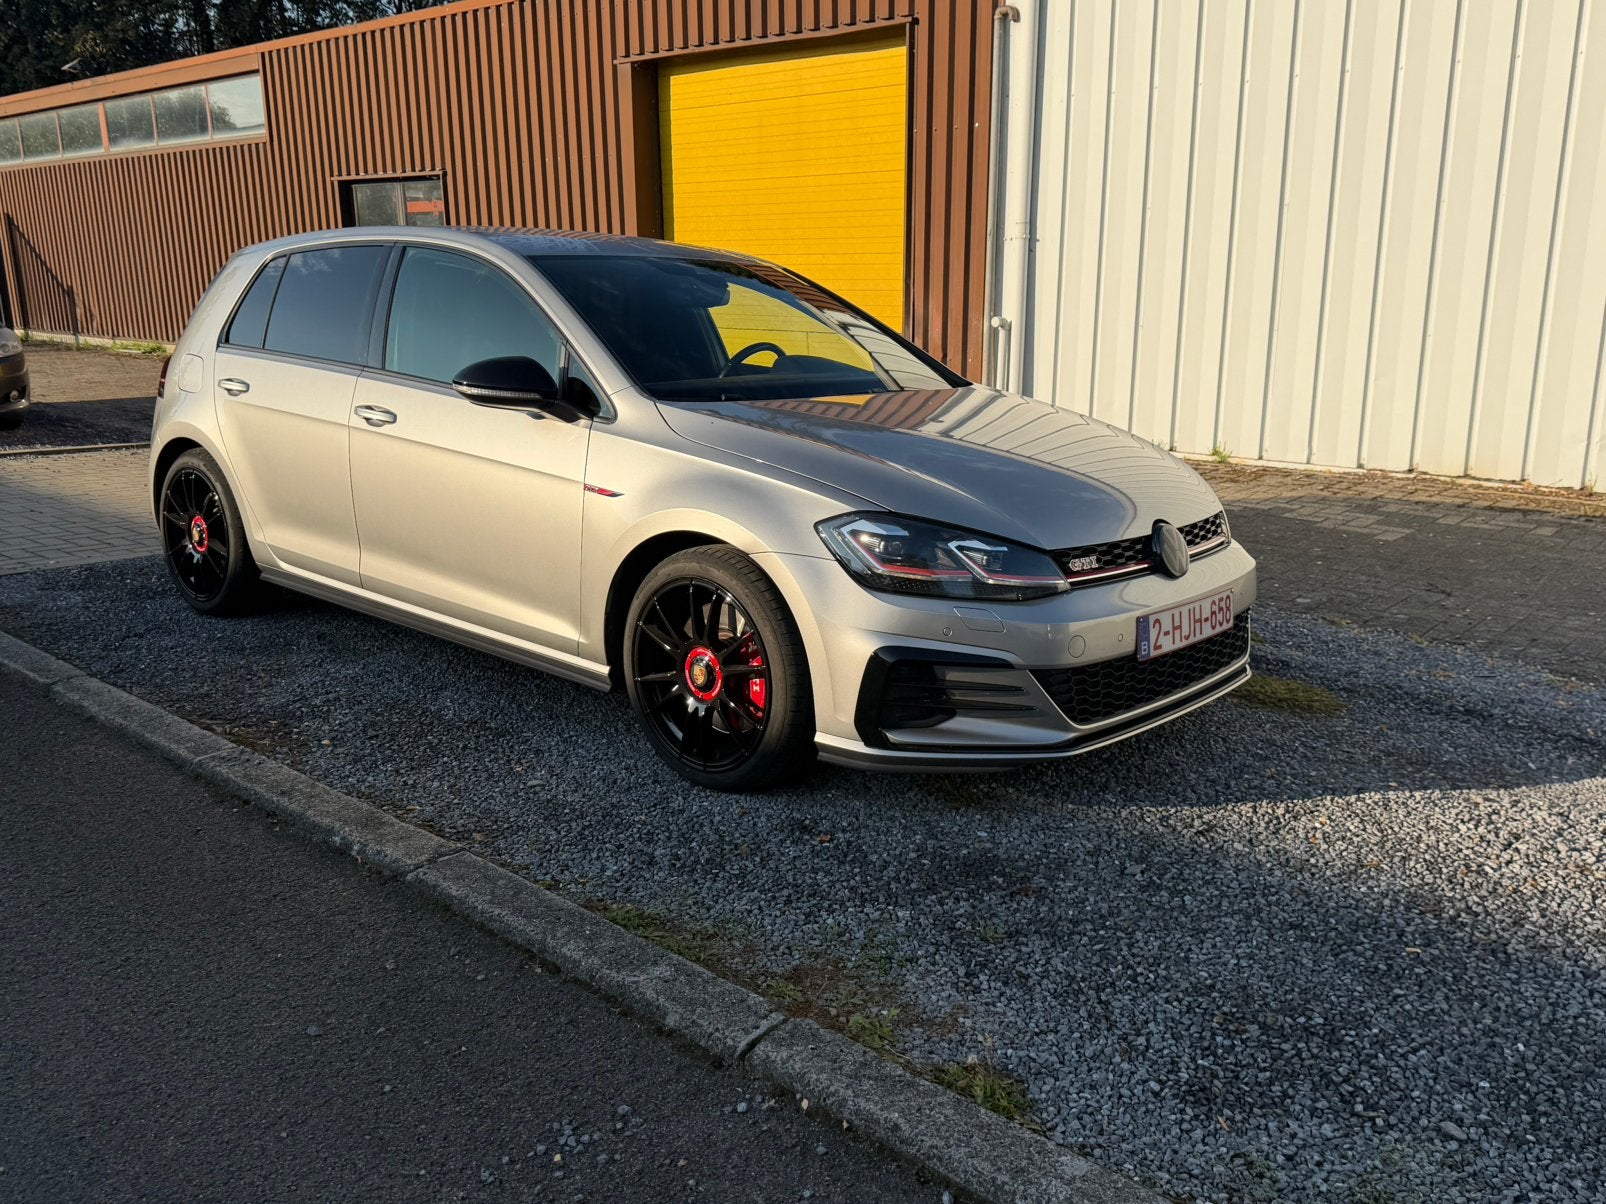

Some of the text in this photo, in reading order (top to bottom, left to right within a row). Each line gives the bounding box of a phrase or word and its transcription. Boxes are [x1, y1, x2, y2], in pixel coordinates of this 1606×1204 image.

[1069, 555, 1099, 572] GTI
[1152, 594, 1232, 652] 2-HJH-658
[1141, 641, 1149, 655] B
